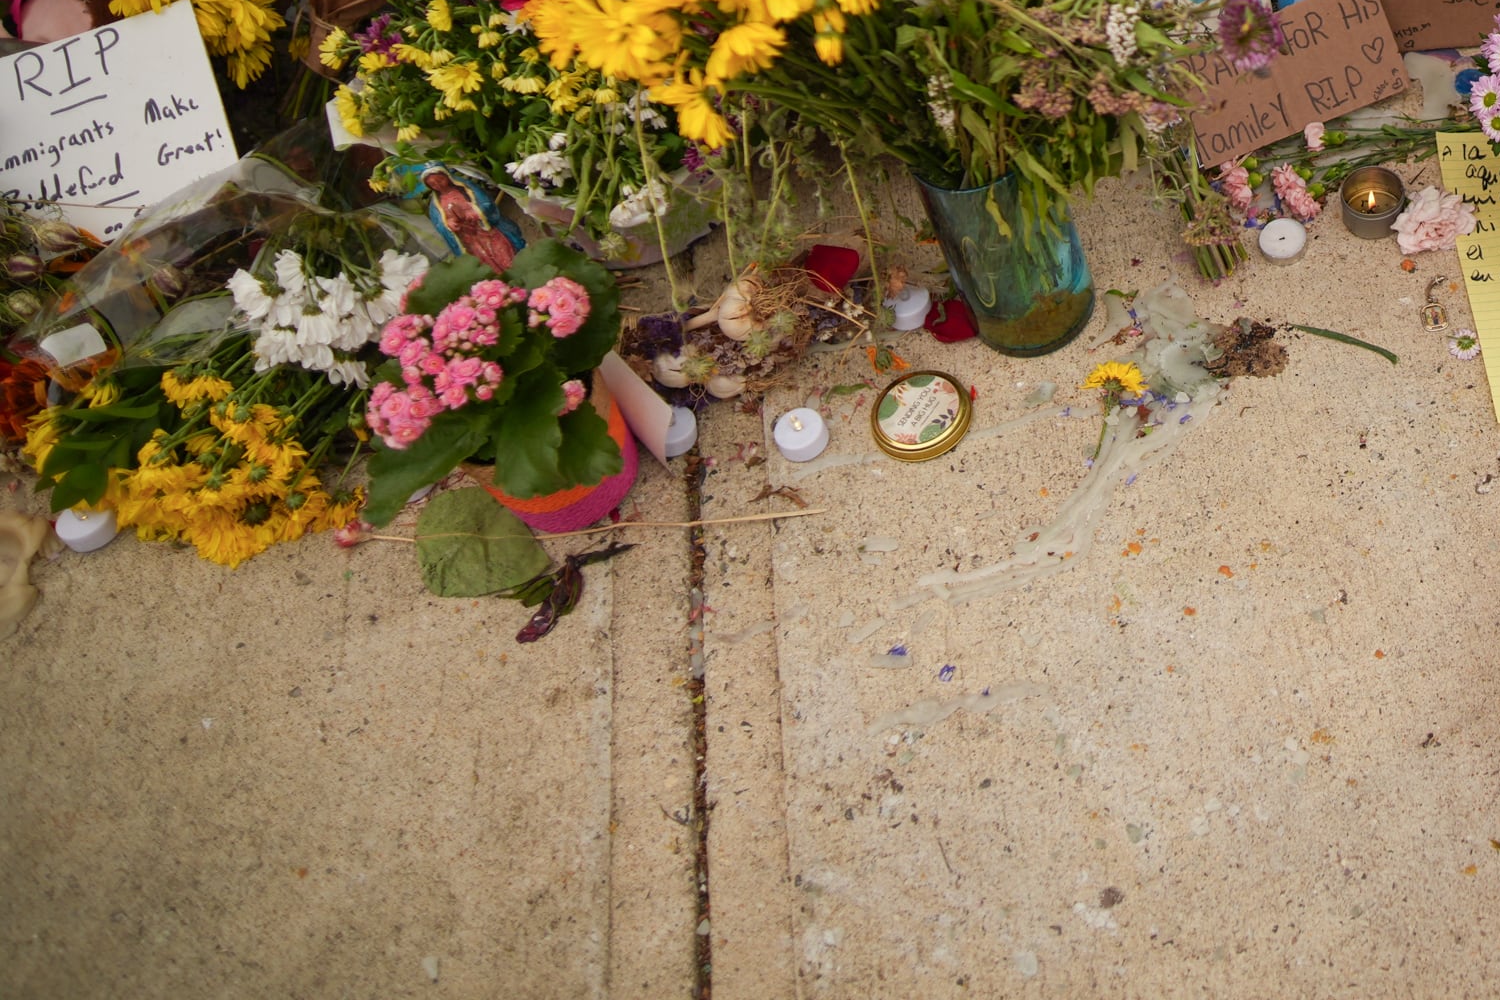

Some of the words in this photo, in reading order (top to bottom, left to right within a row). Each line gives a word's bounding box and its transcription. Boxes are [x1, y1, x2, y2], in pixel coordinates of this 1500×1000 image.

[1280, 11, 1329, 56] FOR
[14, 26, 119, 101] RIP
[0, 119, 115, 173] mmigrants
[144, 94, 199, 126] Make
[158, 128, 225, 167] Great!
[897, 401, 921, 426] SENDING
